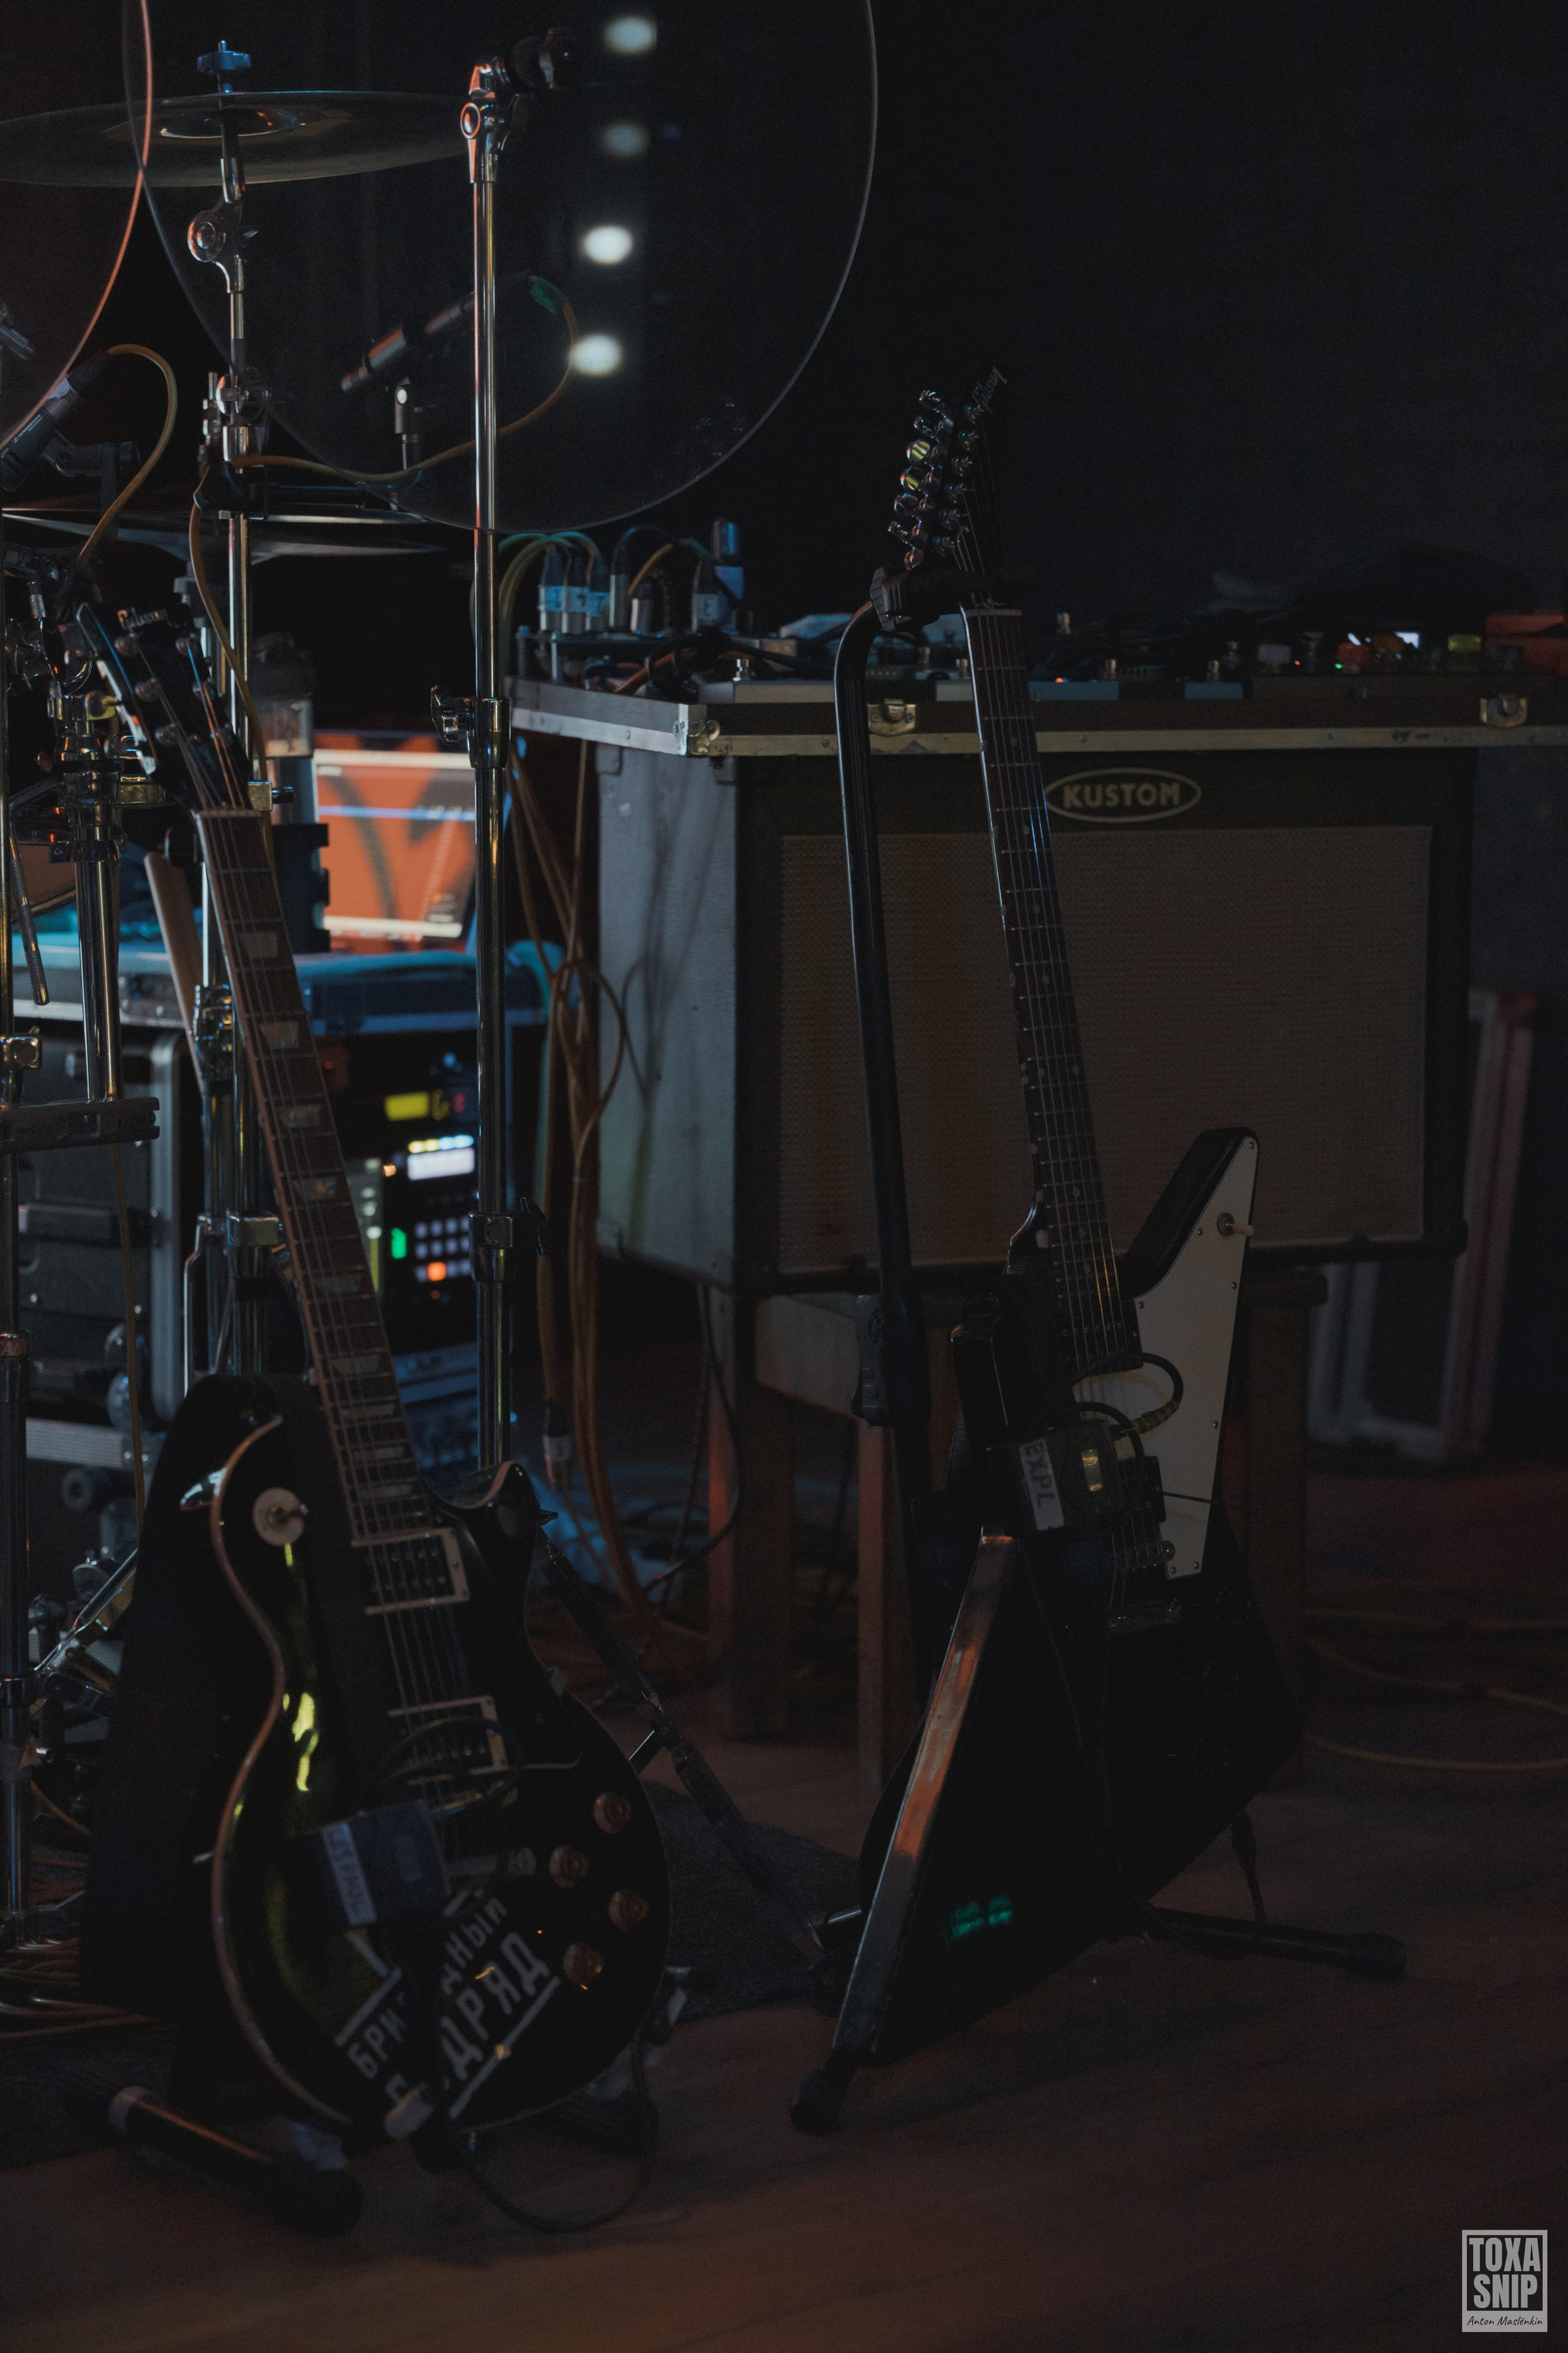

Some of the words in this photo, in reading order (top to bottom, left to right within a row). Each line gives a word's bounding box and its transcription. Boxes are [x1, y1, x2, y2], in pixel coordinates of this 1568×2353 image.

[971, 366, 1008, 415] Gibson
[116, 606, 171, 631] Gibson
[1062, 781, 1181, 809] KUSTOM
[1023, 1442, 1056, 1509] EXPL
